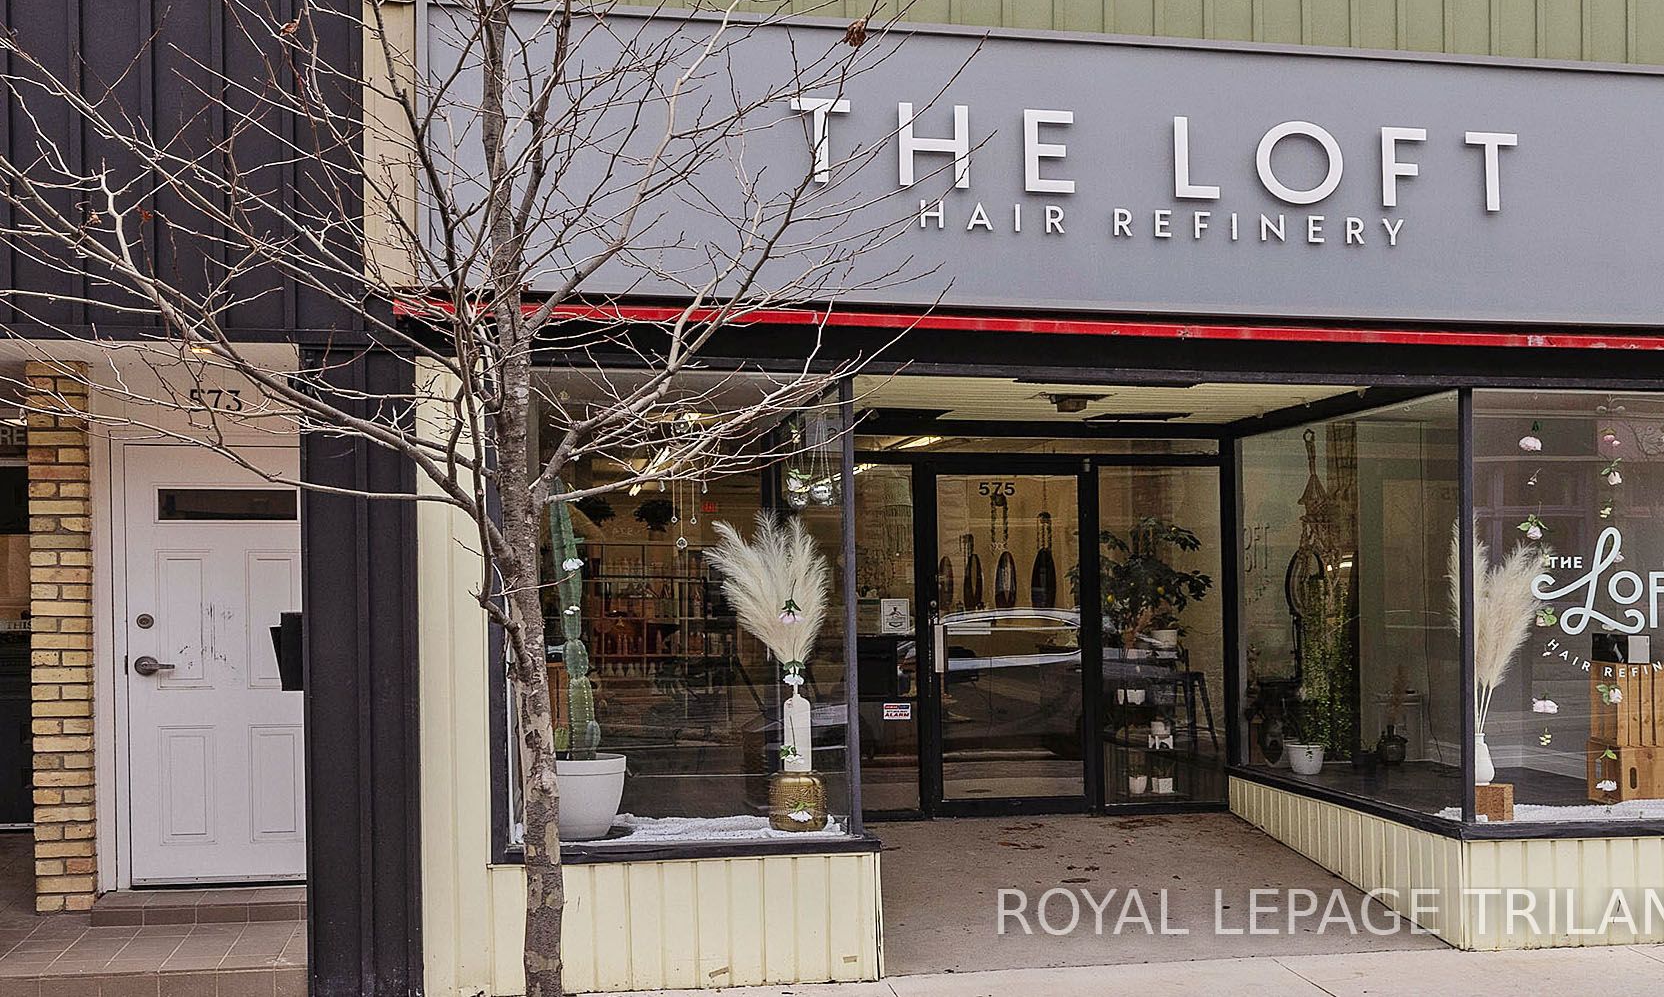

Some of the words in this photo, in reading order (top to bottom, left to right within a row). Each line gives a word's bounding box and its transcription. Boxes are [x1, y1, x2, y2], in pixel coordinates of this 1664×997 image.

[790, 96, 1076, 194] THE
[1173, 115, 1518, 212] LOFT
[919, 199, 1066, 234] HAIR
[1113, 208, 1405, 246] REFINERY
[189, 388, 243, 413] 573
[979, 482, 1016, 496] 575
[1549, 556, 1583, 569] THE
[1547, 638, 1592, 672] HAIR
